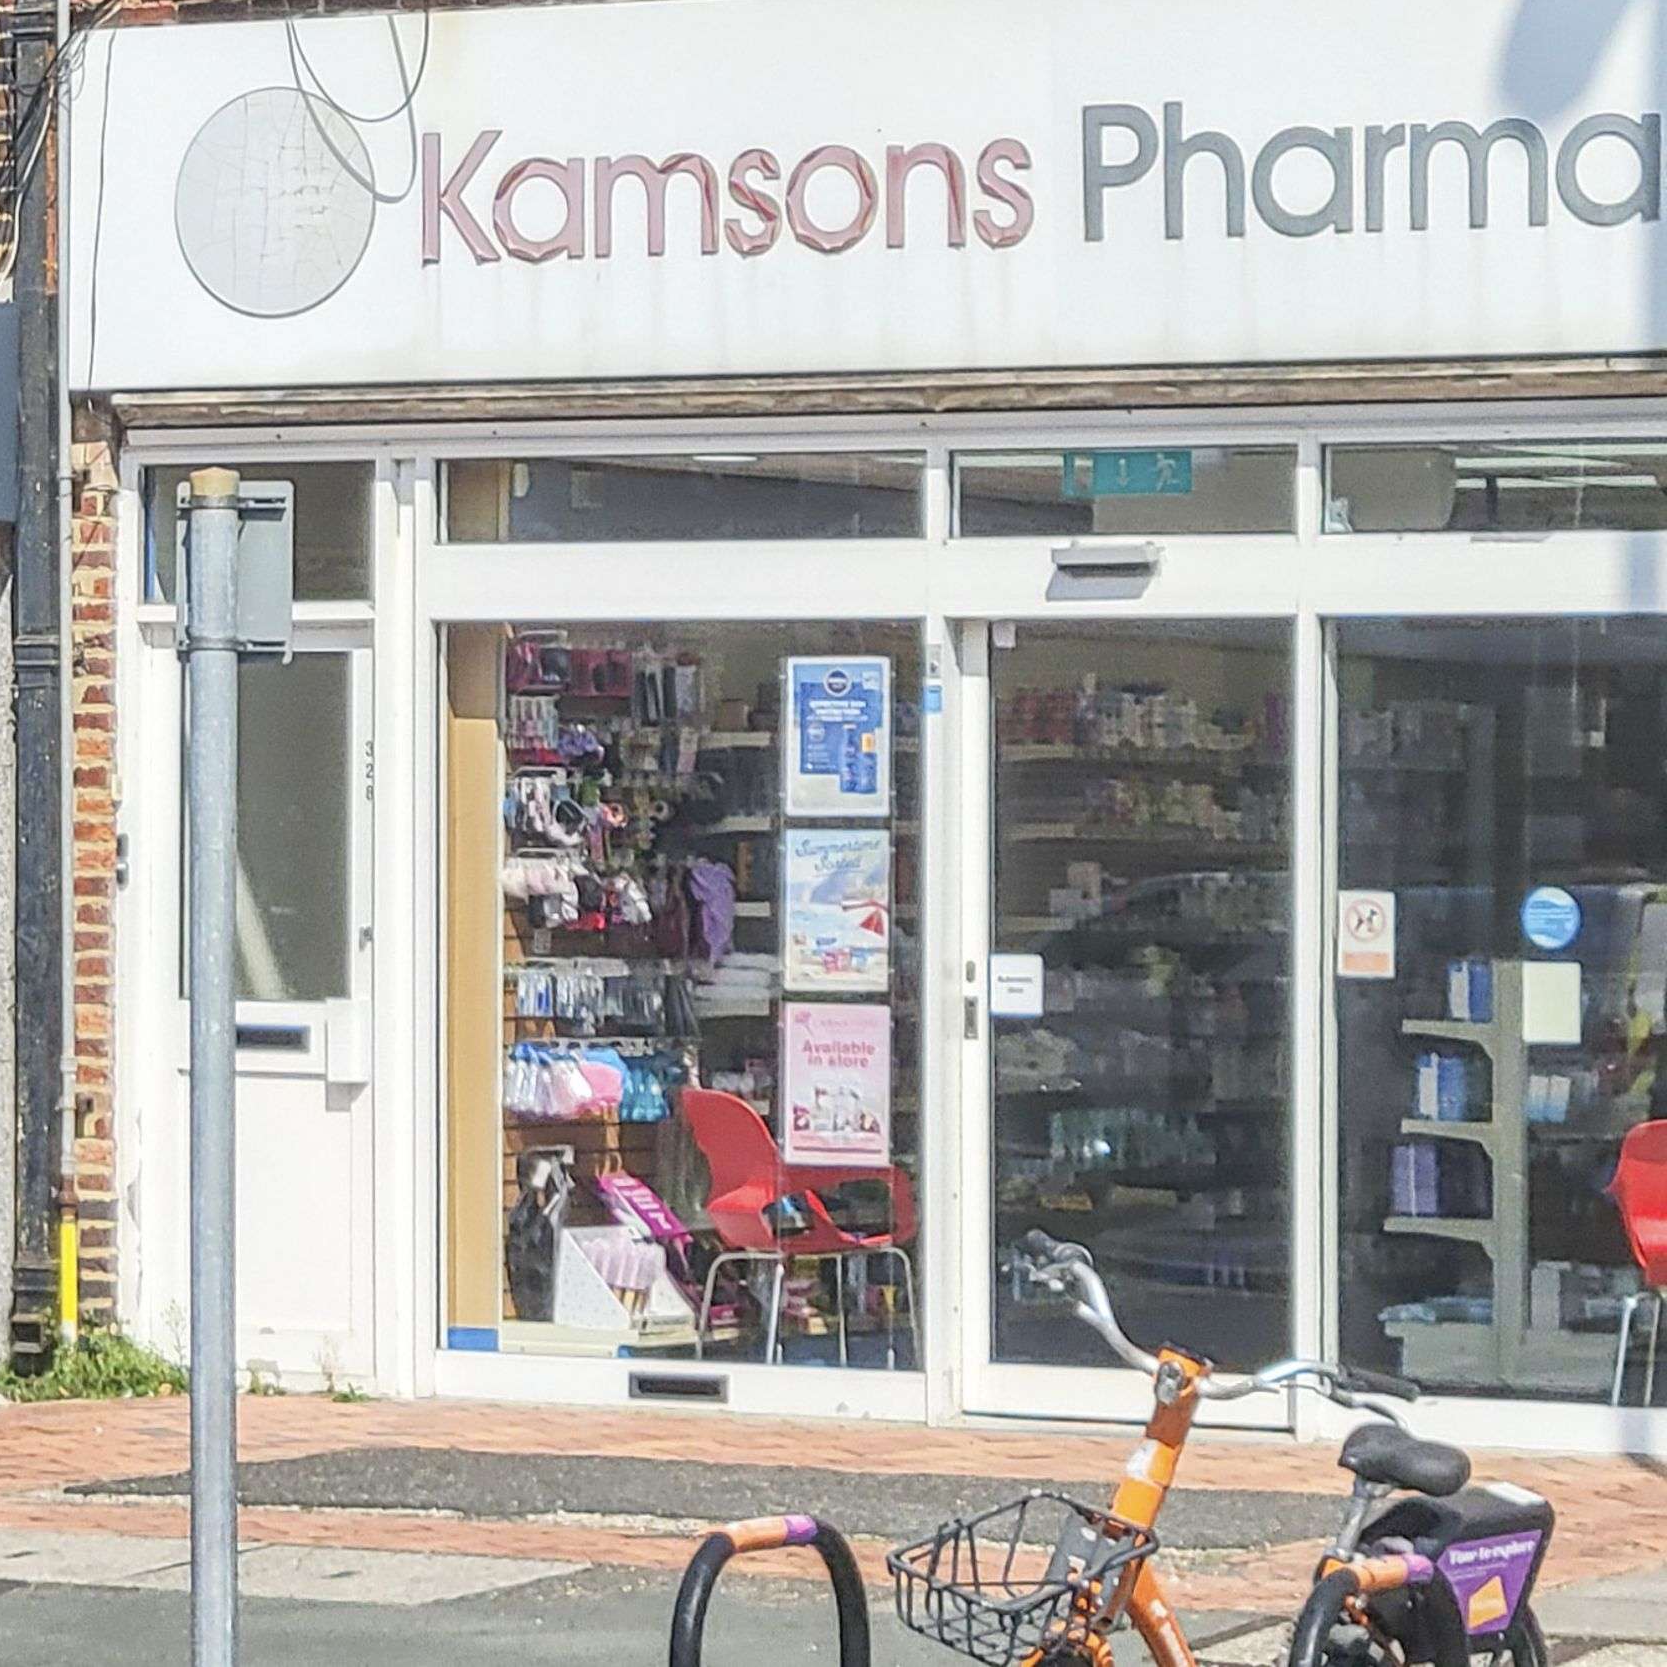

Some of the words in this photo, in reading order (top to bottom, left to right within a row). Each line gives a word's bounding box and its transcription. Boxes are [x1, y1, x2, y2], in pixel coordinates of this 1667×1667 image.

[421, 128, 1037, 265] Kamsons
[1082, 99, 1664, 243] Pharma
[802, 1039, 876, 1056] Available
[807, 1053, 823, 1066] in
[828, 1055, 870, 1068] store
